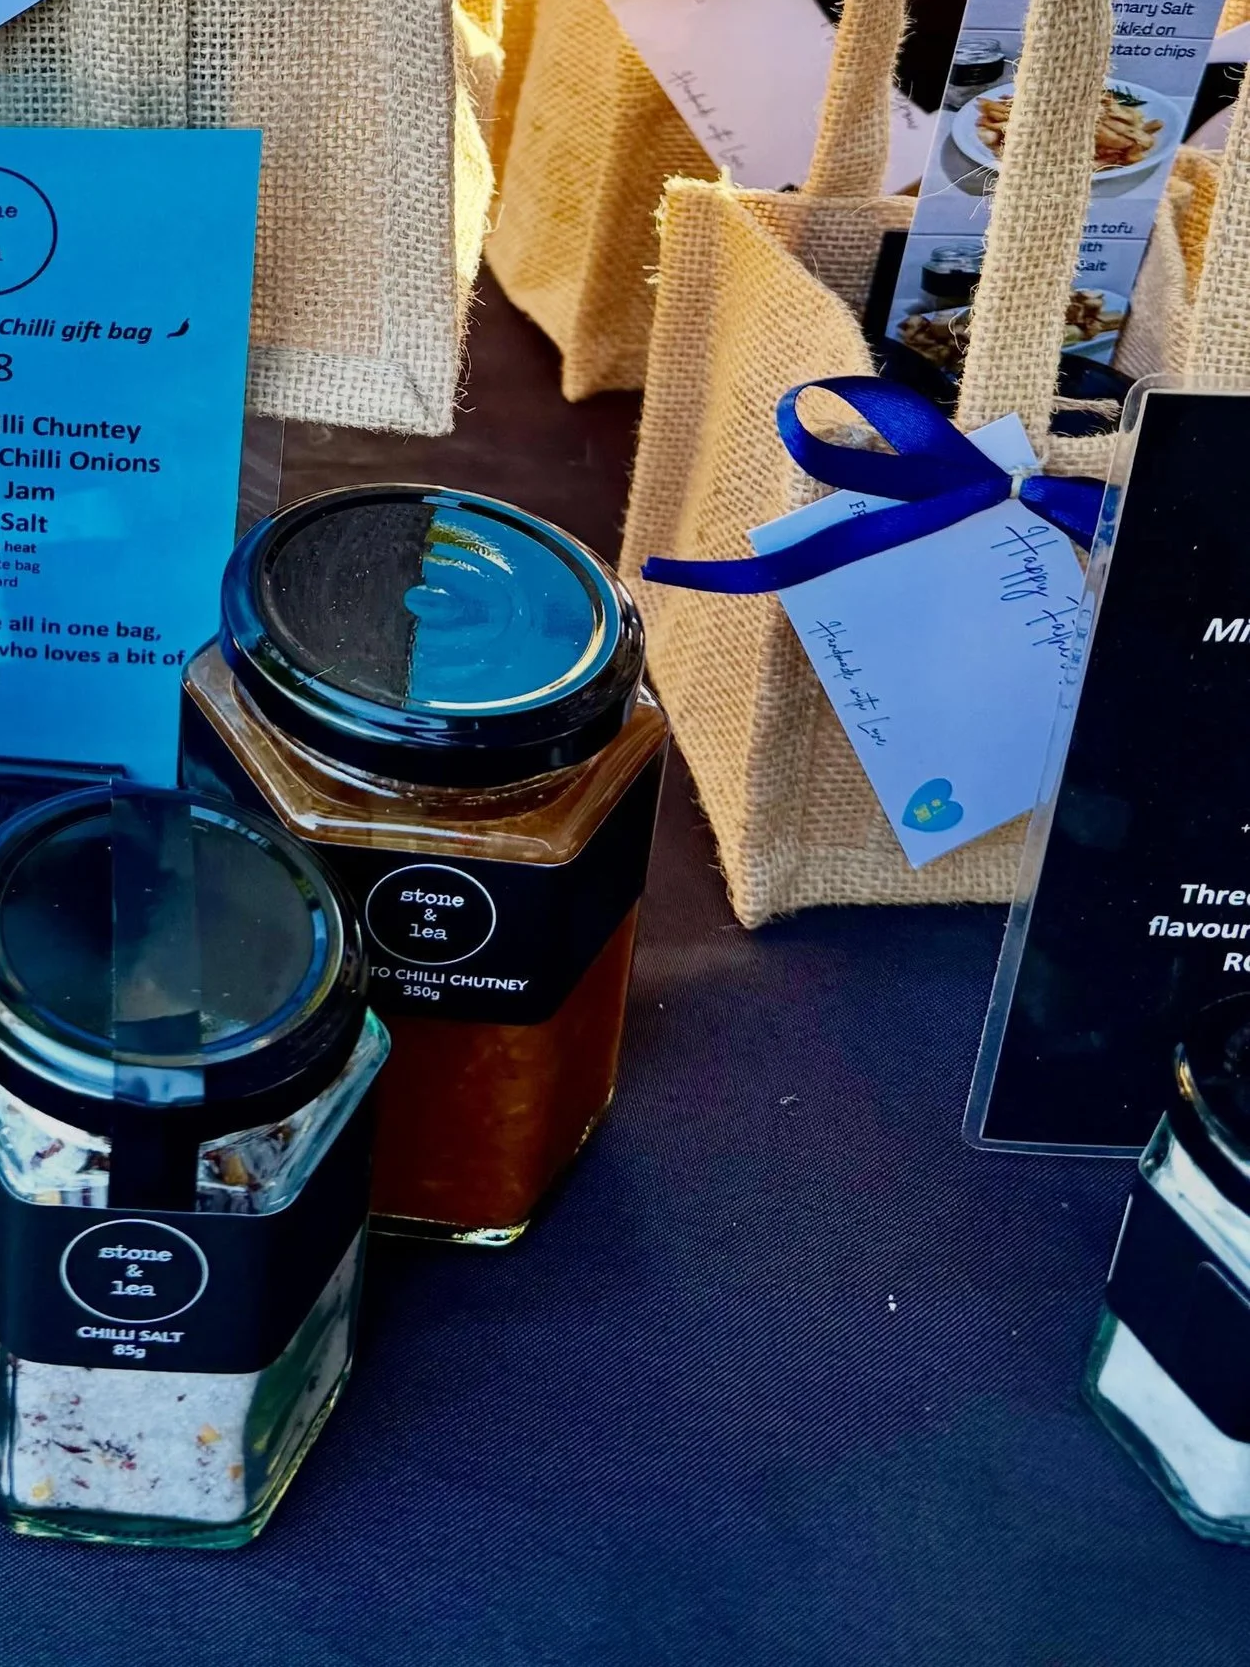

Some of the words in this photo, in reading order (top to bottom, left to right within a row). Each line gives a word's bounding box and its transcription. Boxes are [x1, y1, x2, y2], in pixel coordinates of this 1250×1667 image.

[1110, 2, 1158, 17] mary
[1161, 1, 1196, 15] Salt
[1155, 26, 1176, 36] on
[1154, 44, 1196, 60] chips
[1101, 221, 1134, 234] tofu
[1079, 241, 1103, 253] ith
[0, 317, 55, 337] Chilli
[61, 320, 103, 343] gift
[108, 322, 152, 345] bag
[33, 415, 141, 443] Chuntey
[69, 450, 160, 473] Onions
[4, 480, 55, 501] Jam
[1, 512, 48, 533] Salt
[4, 541, 36, 554] heat
[15, 560, 40, 574] bag
[990, 525, 1059, 601] Happy
[8, 612, 34, 631] all
[40, 616, 60, 633] in
[67, 620, 108, 636] one
[116, 620, 160, 643] bag,
[44, 643, 100, 663] loves
[108, 650, 119, 663] a
[125, 645, 156, 665] bit
[162, 647, 184, 666] of
[400, 889, 465, 909] stone
[1180, 883, 1250, 906] Thre
[424, 909, 437, 921] &
[409, 924, 448, 941] lea
[1149, 915, 1250, 939] flavour
[395, 969, 445, 983] CHILLI
[450, 975, 529, 991] CHUTNEY
[403, 985, 440, 1001] 350g
[98, 1245, 172, 1263] stone
[126, 1264, 143, 1278] &
[111, 1280, 156, 1297] lea
[77, 1326, 136, 1343] CHILLI
[140, 1330, 184, 1344] SALT
[112, 1344, 146, 1359] 85g
